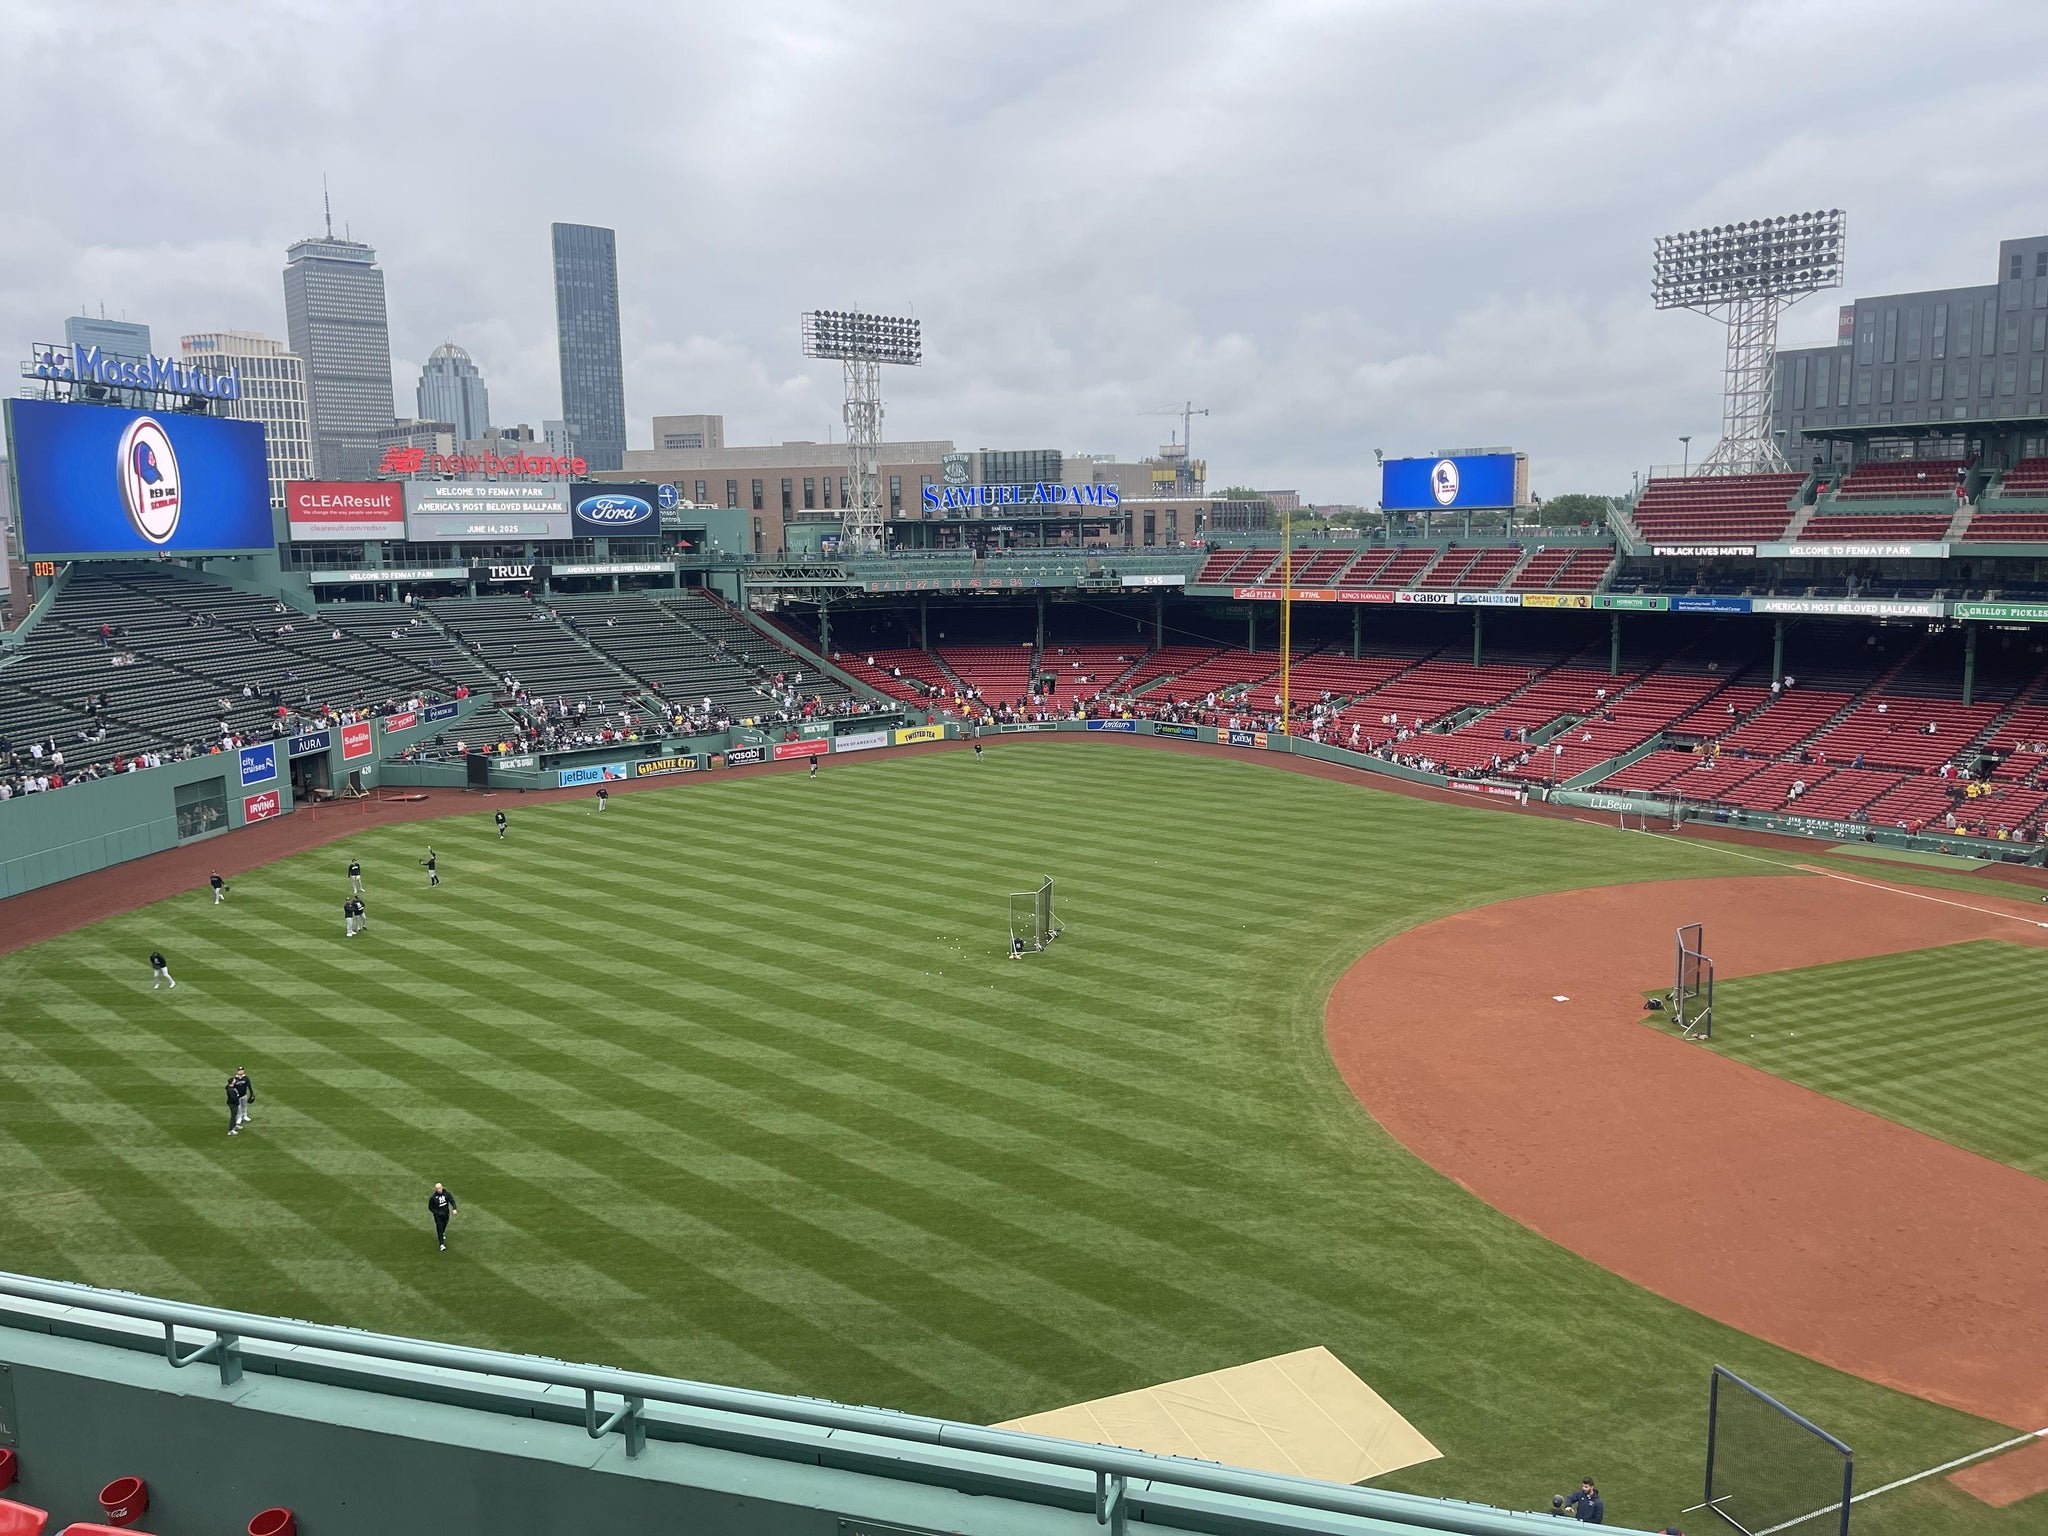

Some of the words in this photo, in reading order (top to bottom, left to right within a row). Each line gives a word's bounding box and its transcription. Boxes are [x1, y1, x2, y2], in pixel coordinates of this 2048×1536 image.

[73, 343, 240, 400] MassMutual
[429, 453, 483, 473] new
[485, 449, 588, 475] balance
[150, 488, 164, 499] RED
[436, 488, 474, 496] WELCOME
[477, 488, 486, 496] TO
[488, 488, 519, 496] FENWAY
[522, 488, 543, 496] PARK
[923, 484, 1027, 513] SAMUEL
[1031, 481, 1120, 507] ADAMS
[299, 494, 391, 507] CLEAResult
[418, 503, 461, 511] AMERICA'S
[463, 503, 484, 511] MOST
[486, 503, 521, 511] BELOVED
[523, 503, 562, 511] BALLPARK
[592, 499, 637, 520] Ford
[311, 524, 386, 532] clearesult.com/redsox
[467, 526, 486, 534] JUNE
[487, 526, 497, 534] 14,
[1667, 547, 1695, 556] BLACK
[1696, 547, 1718, 556] LIVES
[1719, 547, 1755, 556] MATTER
[1789, 546, 1829, 555] WELCOME
[1832, 546, 1842, 555] TO
[1845, 546, 1882, 555] FENWAY
[1885, 546, 1911, 555] PARK
[488, 565, 535, 578] TRULY
[1030, 577, 1041, 587] 42
[1144, 576, 1163, 585] 5:45
[1256, 591, 1277, 599] PIZZA
[1412, 593, 1449, 603] CABOT
[1478, 595, 1519, 604] CALL128.COM
[1765, 602, 1809, 611] AMERICA'S
[1811, 603, 1836, 612] MOST
[1838, 603, 1877, 612] BELOVED
[1881, 604, 1929, 615] BALLPARK
[1970, 607, 2006, 616] GRILLO'S
[2010, 608, 2048, 617] PICKLES
[1100, 720, 1130, 730] Jordan's
[345, 733, 369, 745] Safelite
[905, 731, 925, 742] TWISTED
[926, 731, 936, 739] TEA
[728, 748, 760, 762] wasabi
[242, 757, 255, 767] city
[500, 759, 522, 770] DICK'S
[638, 758, 677, 775] GRANITE
[678, 757, 697, 769] CITY
[243, 763, 266, 775] cruises
[361, 765, 372, 775] 420
[563, 770, 599, 786] jetBlue
[249, 799, 275, 814] IRVING
[1590, 798, 1632, 811] L.L.Bean
